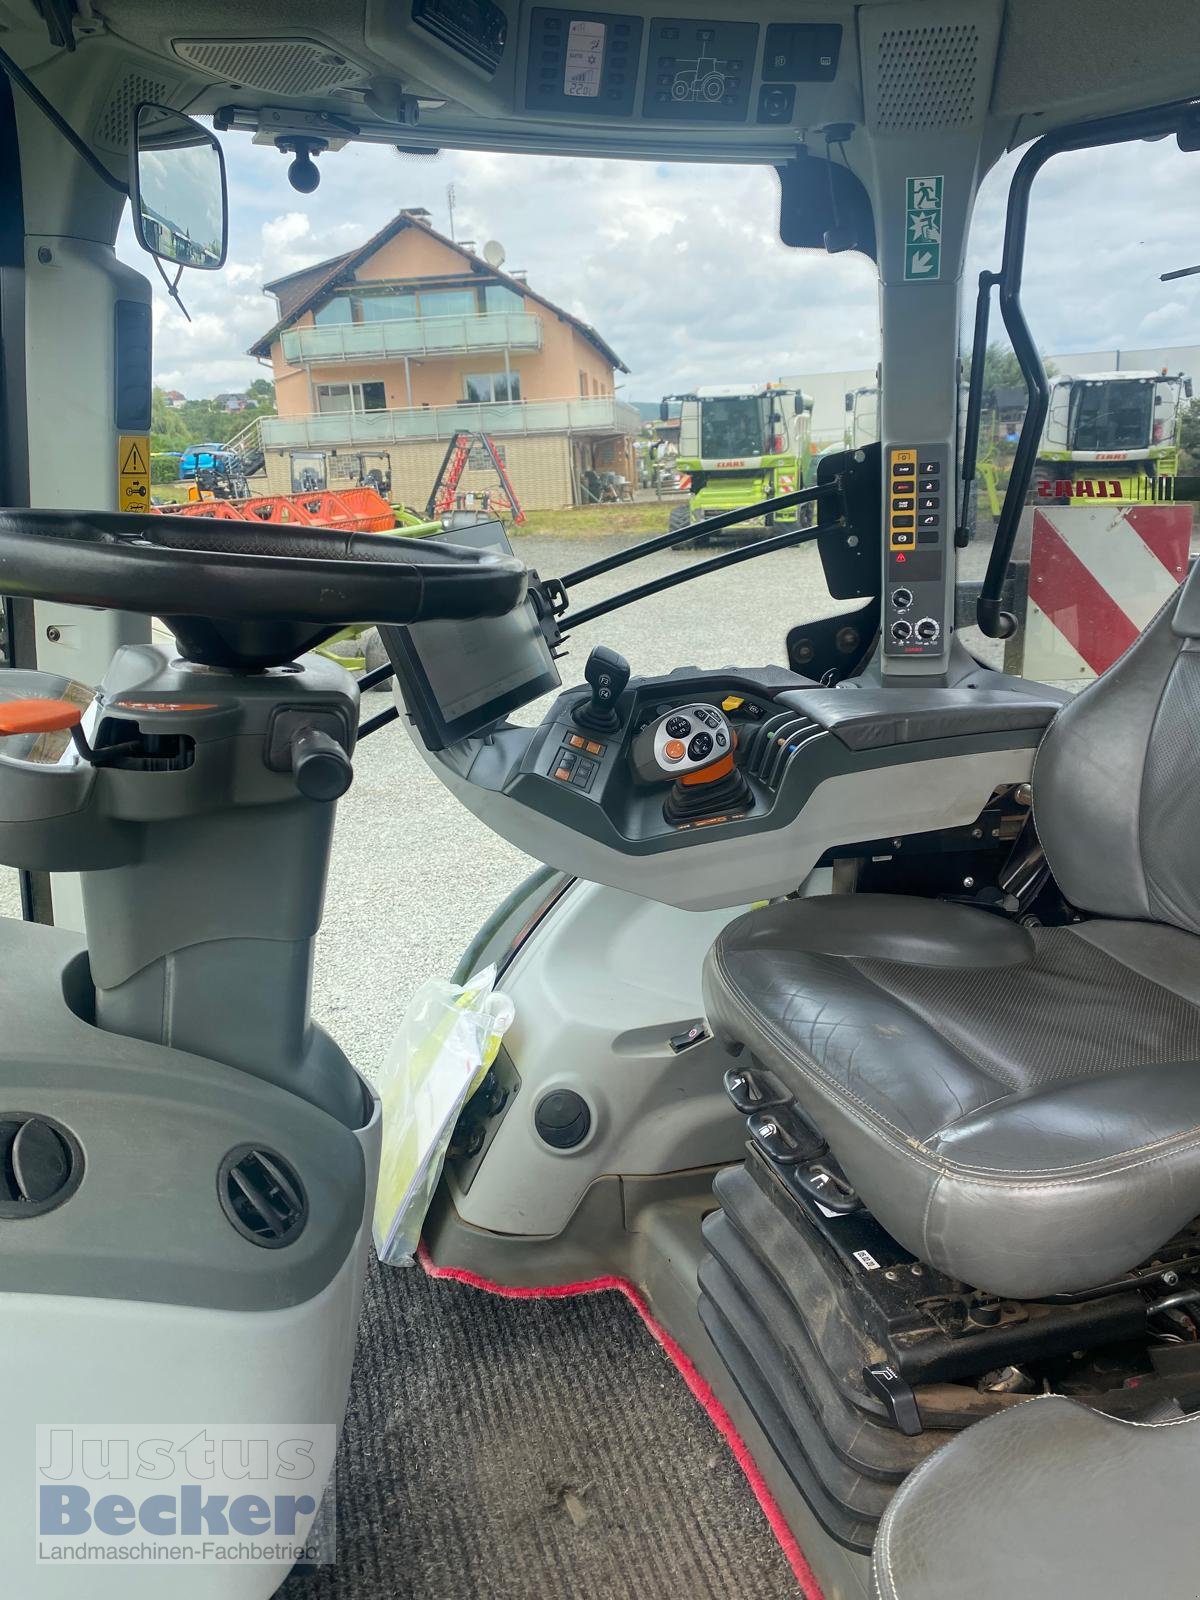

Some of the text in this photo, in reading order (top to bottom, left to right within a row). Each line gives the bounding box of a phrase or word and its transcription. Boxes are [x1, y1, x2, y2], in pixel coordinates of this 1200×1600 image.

[1095, 452, 1128, 461] CLAAS
[600, 677, 609, 685] F3
[600, 690, 609, 698] F4
